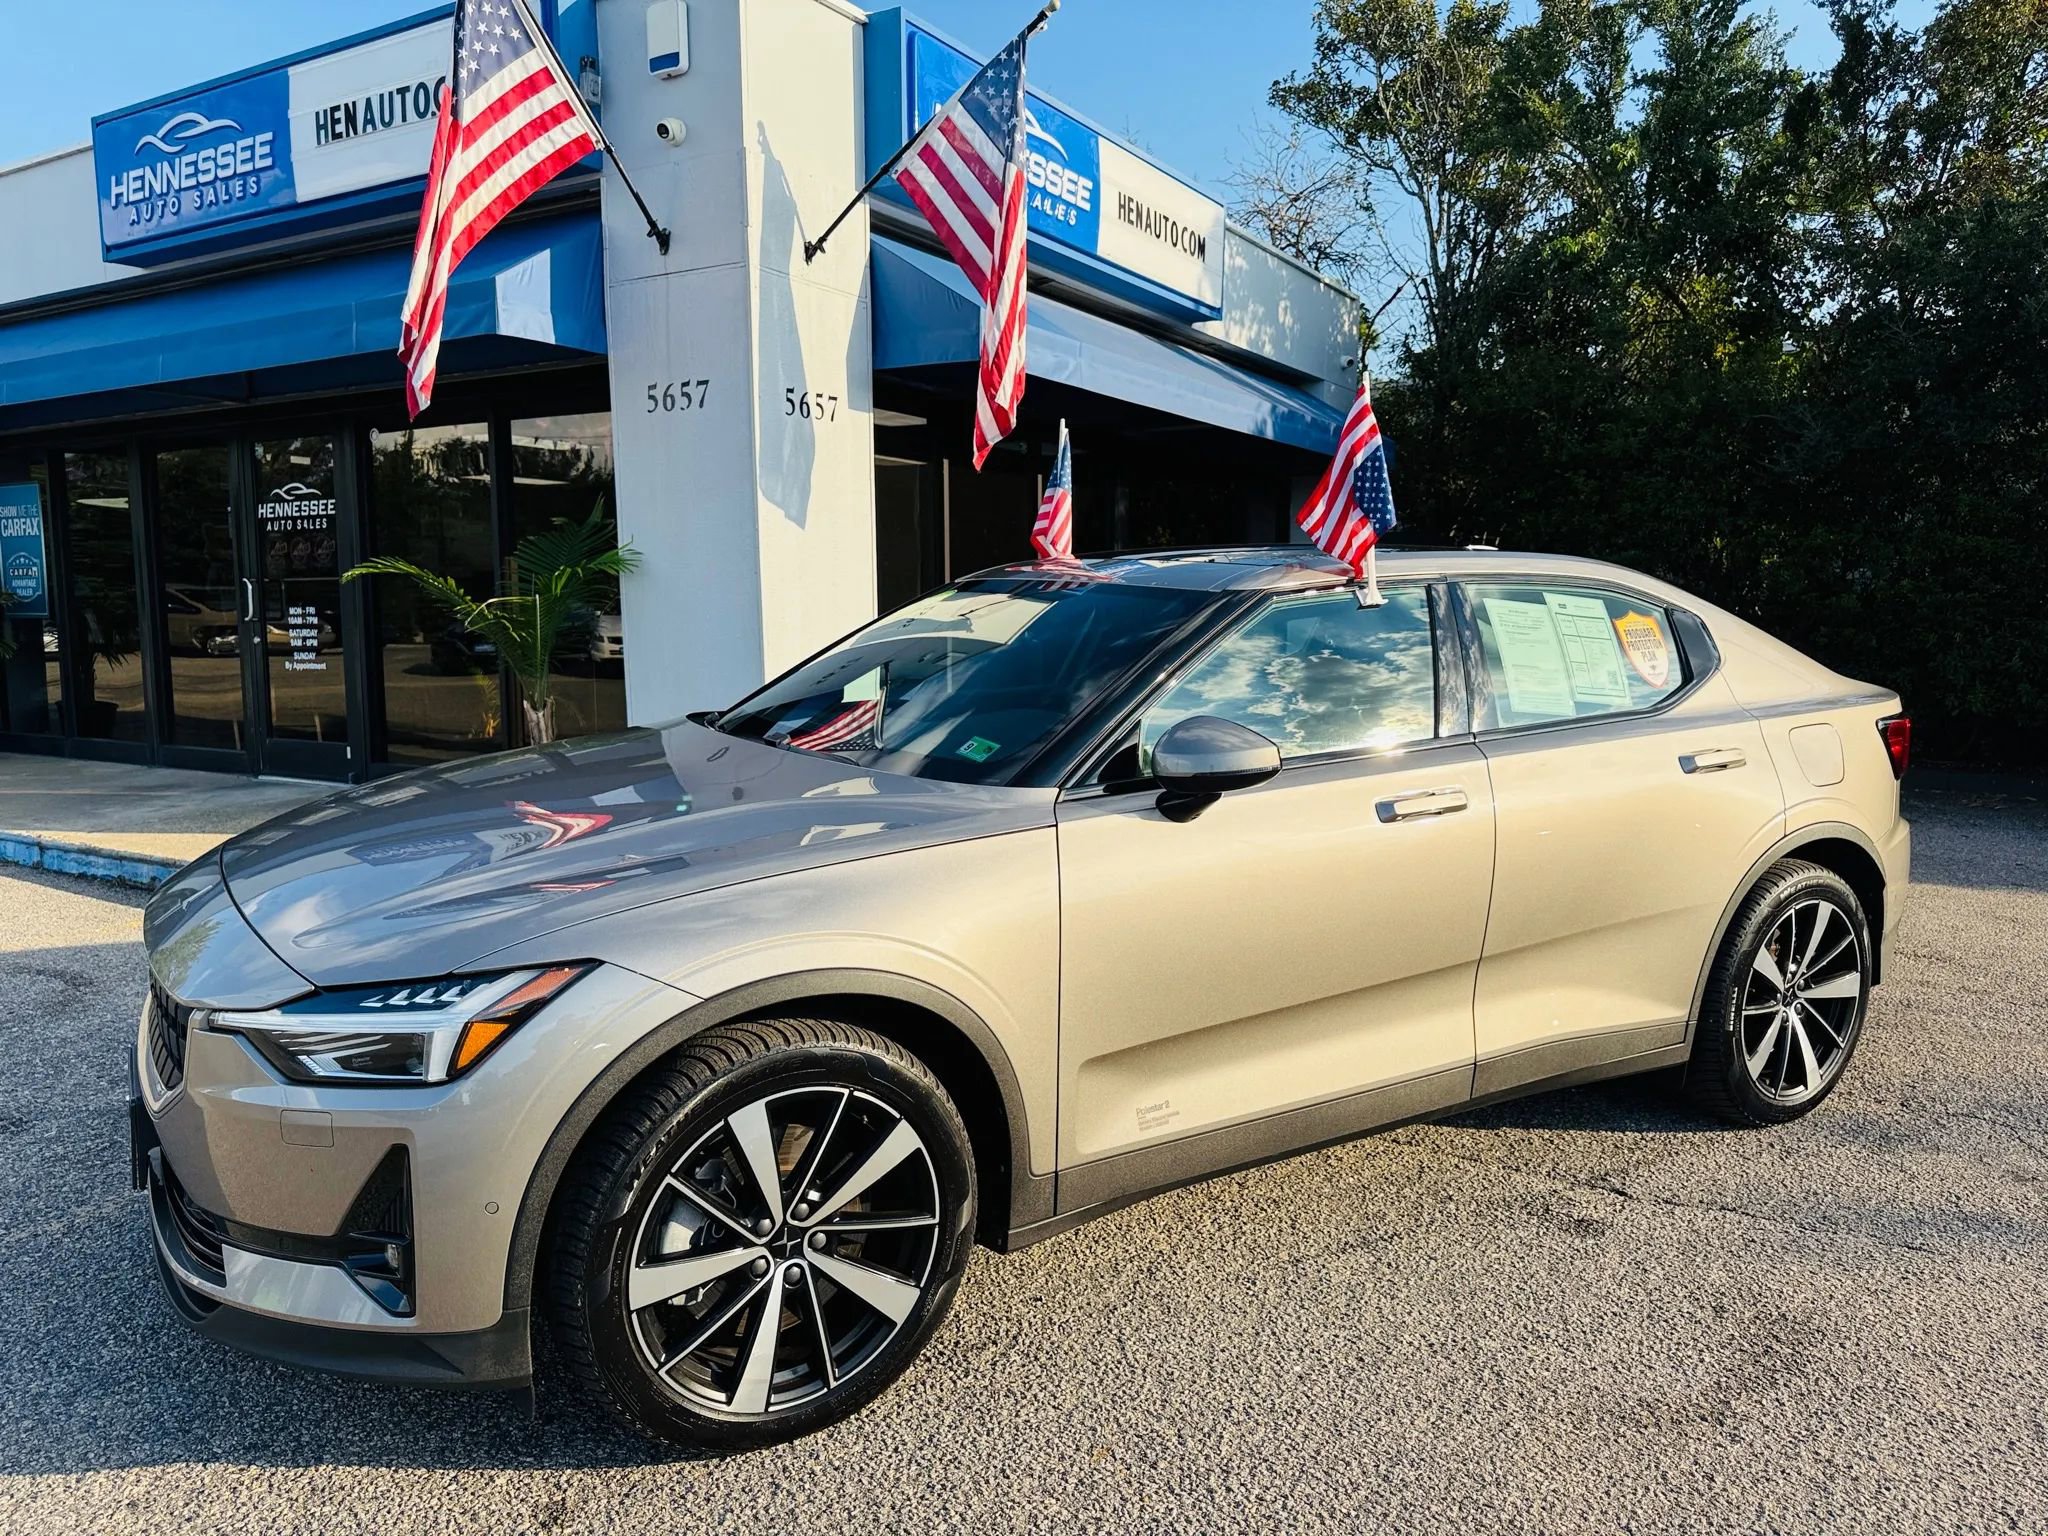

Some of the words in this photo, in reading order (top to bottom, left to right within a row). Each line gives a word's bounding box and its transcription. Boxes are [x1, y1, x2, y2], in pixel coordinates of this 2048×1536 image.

[111, 132, 273, 208] HENNESSEE
[130, 197, 179, 224] AUTO
[194, 176, 259, 208] SALES
[647, 379, 710, 414] 5657
[785, 386, 839, 423] 5657
[0, 504, 17, 518] SHOW
[18, 504, 27, 517] ME
[28, 503, 39, 516] THE
[258, 499, 336, 519] HENNESSEE
[1, 517, 40, 537] CARFAX
[266, 520, 293, 532] AUTO
[297, 517, 327, 530] SALES
[12, 578, 37, 588] ADVANTAGE
[289, 606, 302, 615] MON
[306, 606, 315, 615] FRI
[289, 628, 318, 637] SATURDAY
[1626, 638, 1664, 651] PROTECTION
[293, 651, 316, 660] SUNDAY
[1640, 650, 1658, 663] PLAN
[285, 661, 292, 671] By
[293, 661, 327, 671] Appointment
